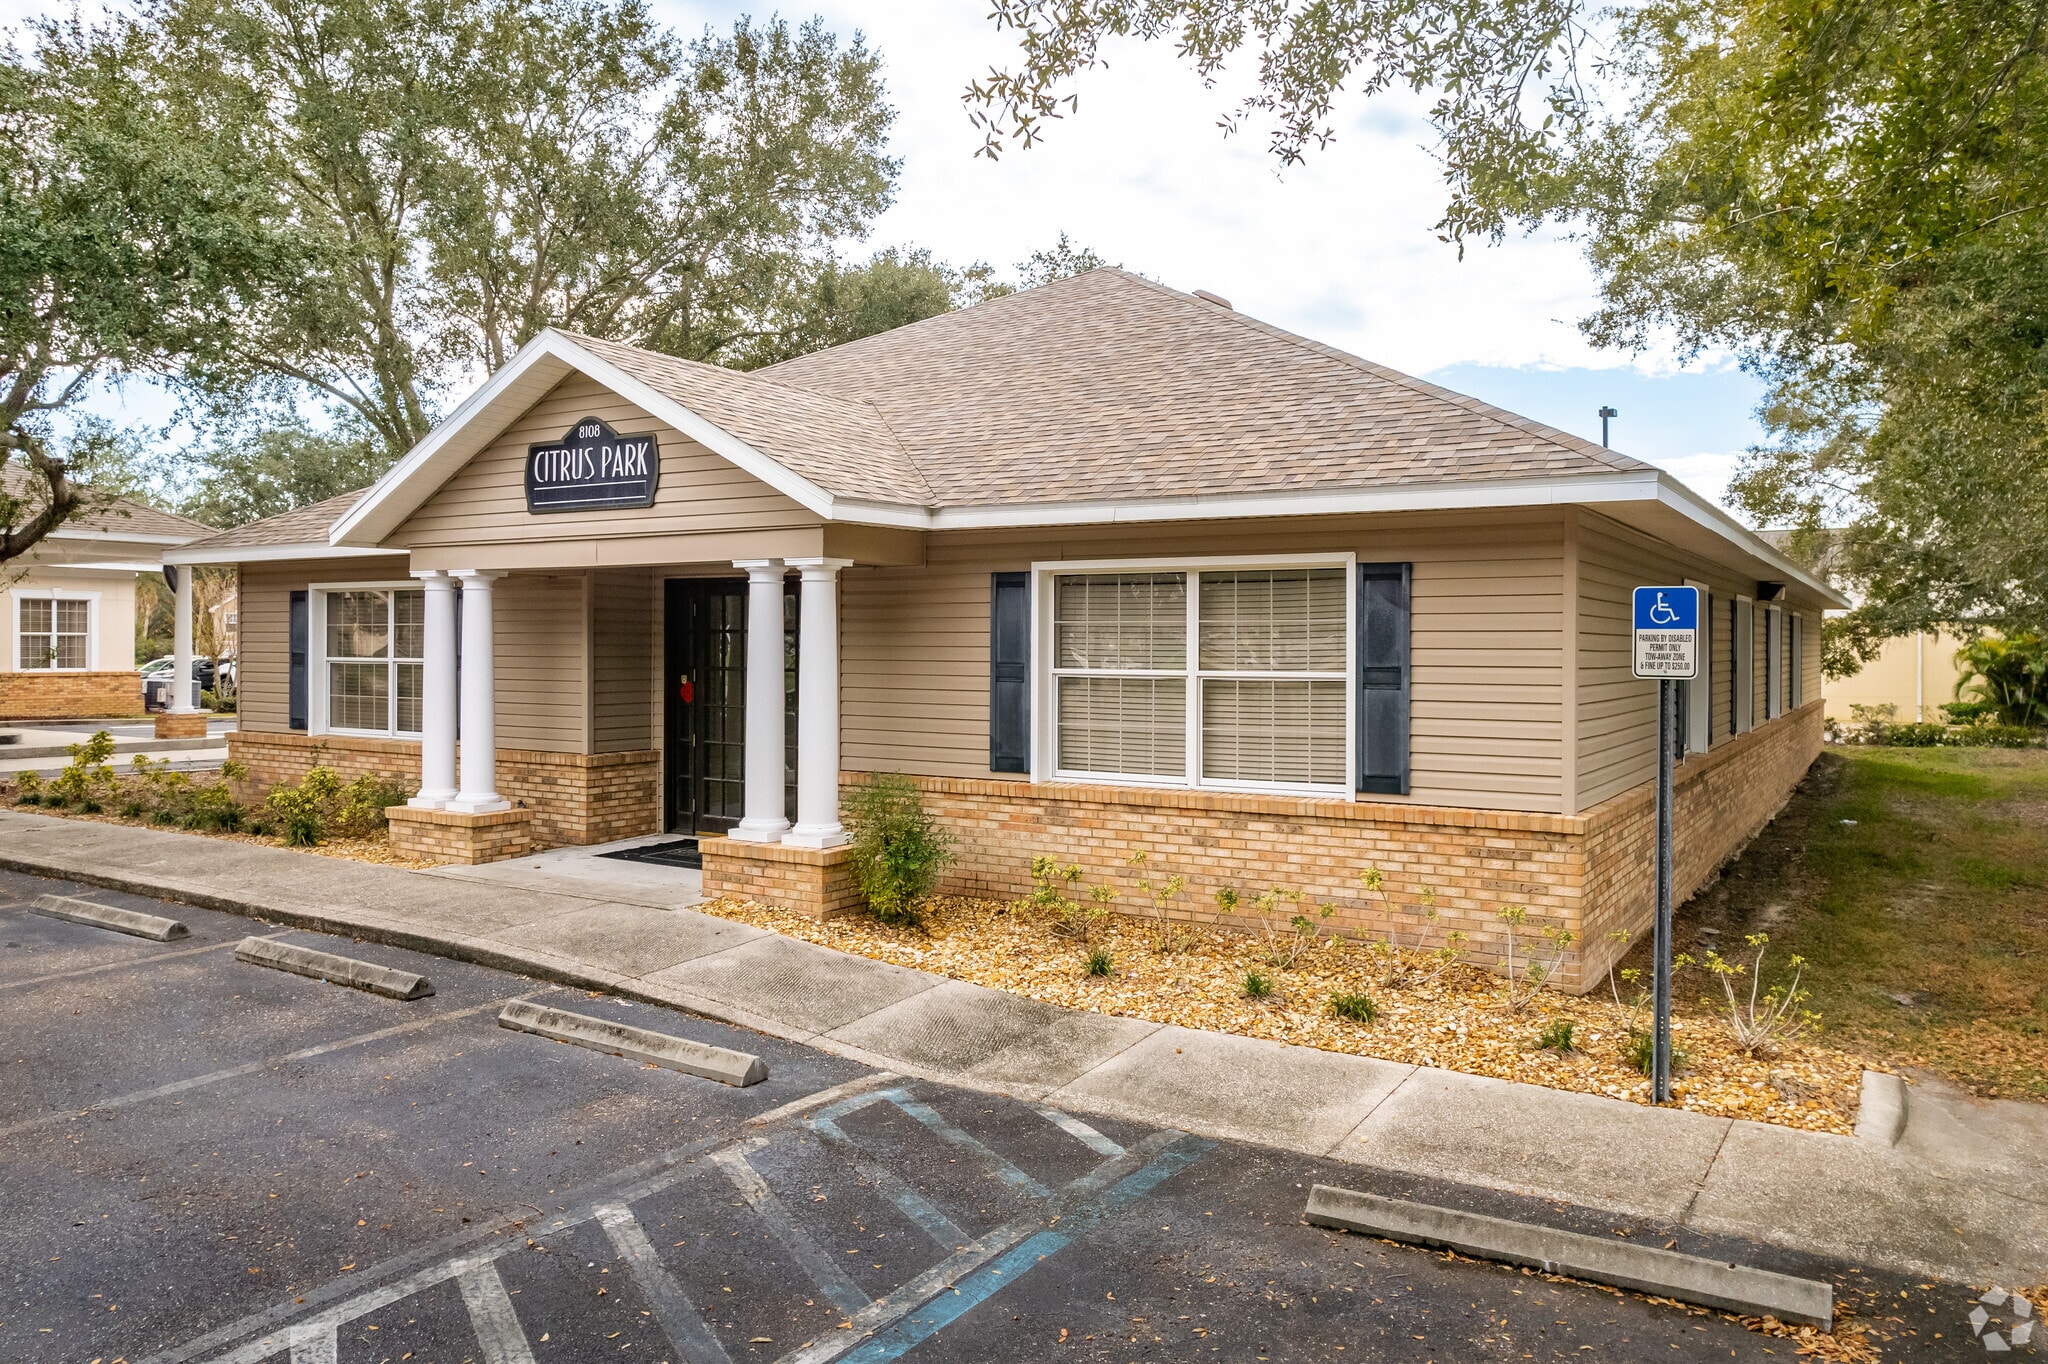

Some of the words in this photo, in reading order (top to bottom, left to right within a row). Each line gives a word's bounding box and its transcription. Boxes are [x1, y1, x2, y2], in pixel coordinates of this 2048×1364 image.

[579, 424, 600, 438] 8108
[534, 447, 595, 483] CITRUS
[601, 442, 649, 478] PARK
[1639, 634, 1660, 642] PARKING
[1661, 634, 1667, 642] BY
[1669, 634, 1692, 642] DISABLED
[1649, 643, 1668, 651] PERMIT
[1669, 643, 1681, 651] ONLY
[1645, 652, 1672, 660] TOW-AWAY
[1673, 653, 1685, 661] ZONE
[1640, 661, 1644, 669] &
[1645, 661, 1656, 669] FINE
[1657, 661, 1664, 669] UP
[1664, 661, 1670, 669] TO
[1672, 662, 1690, 670] $250.00
